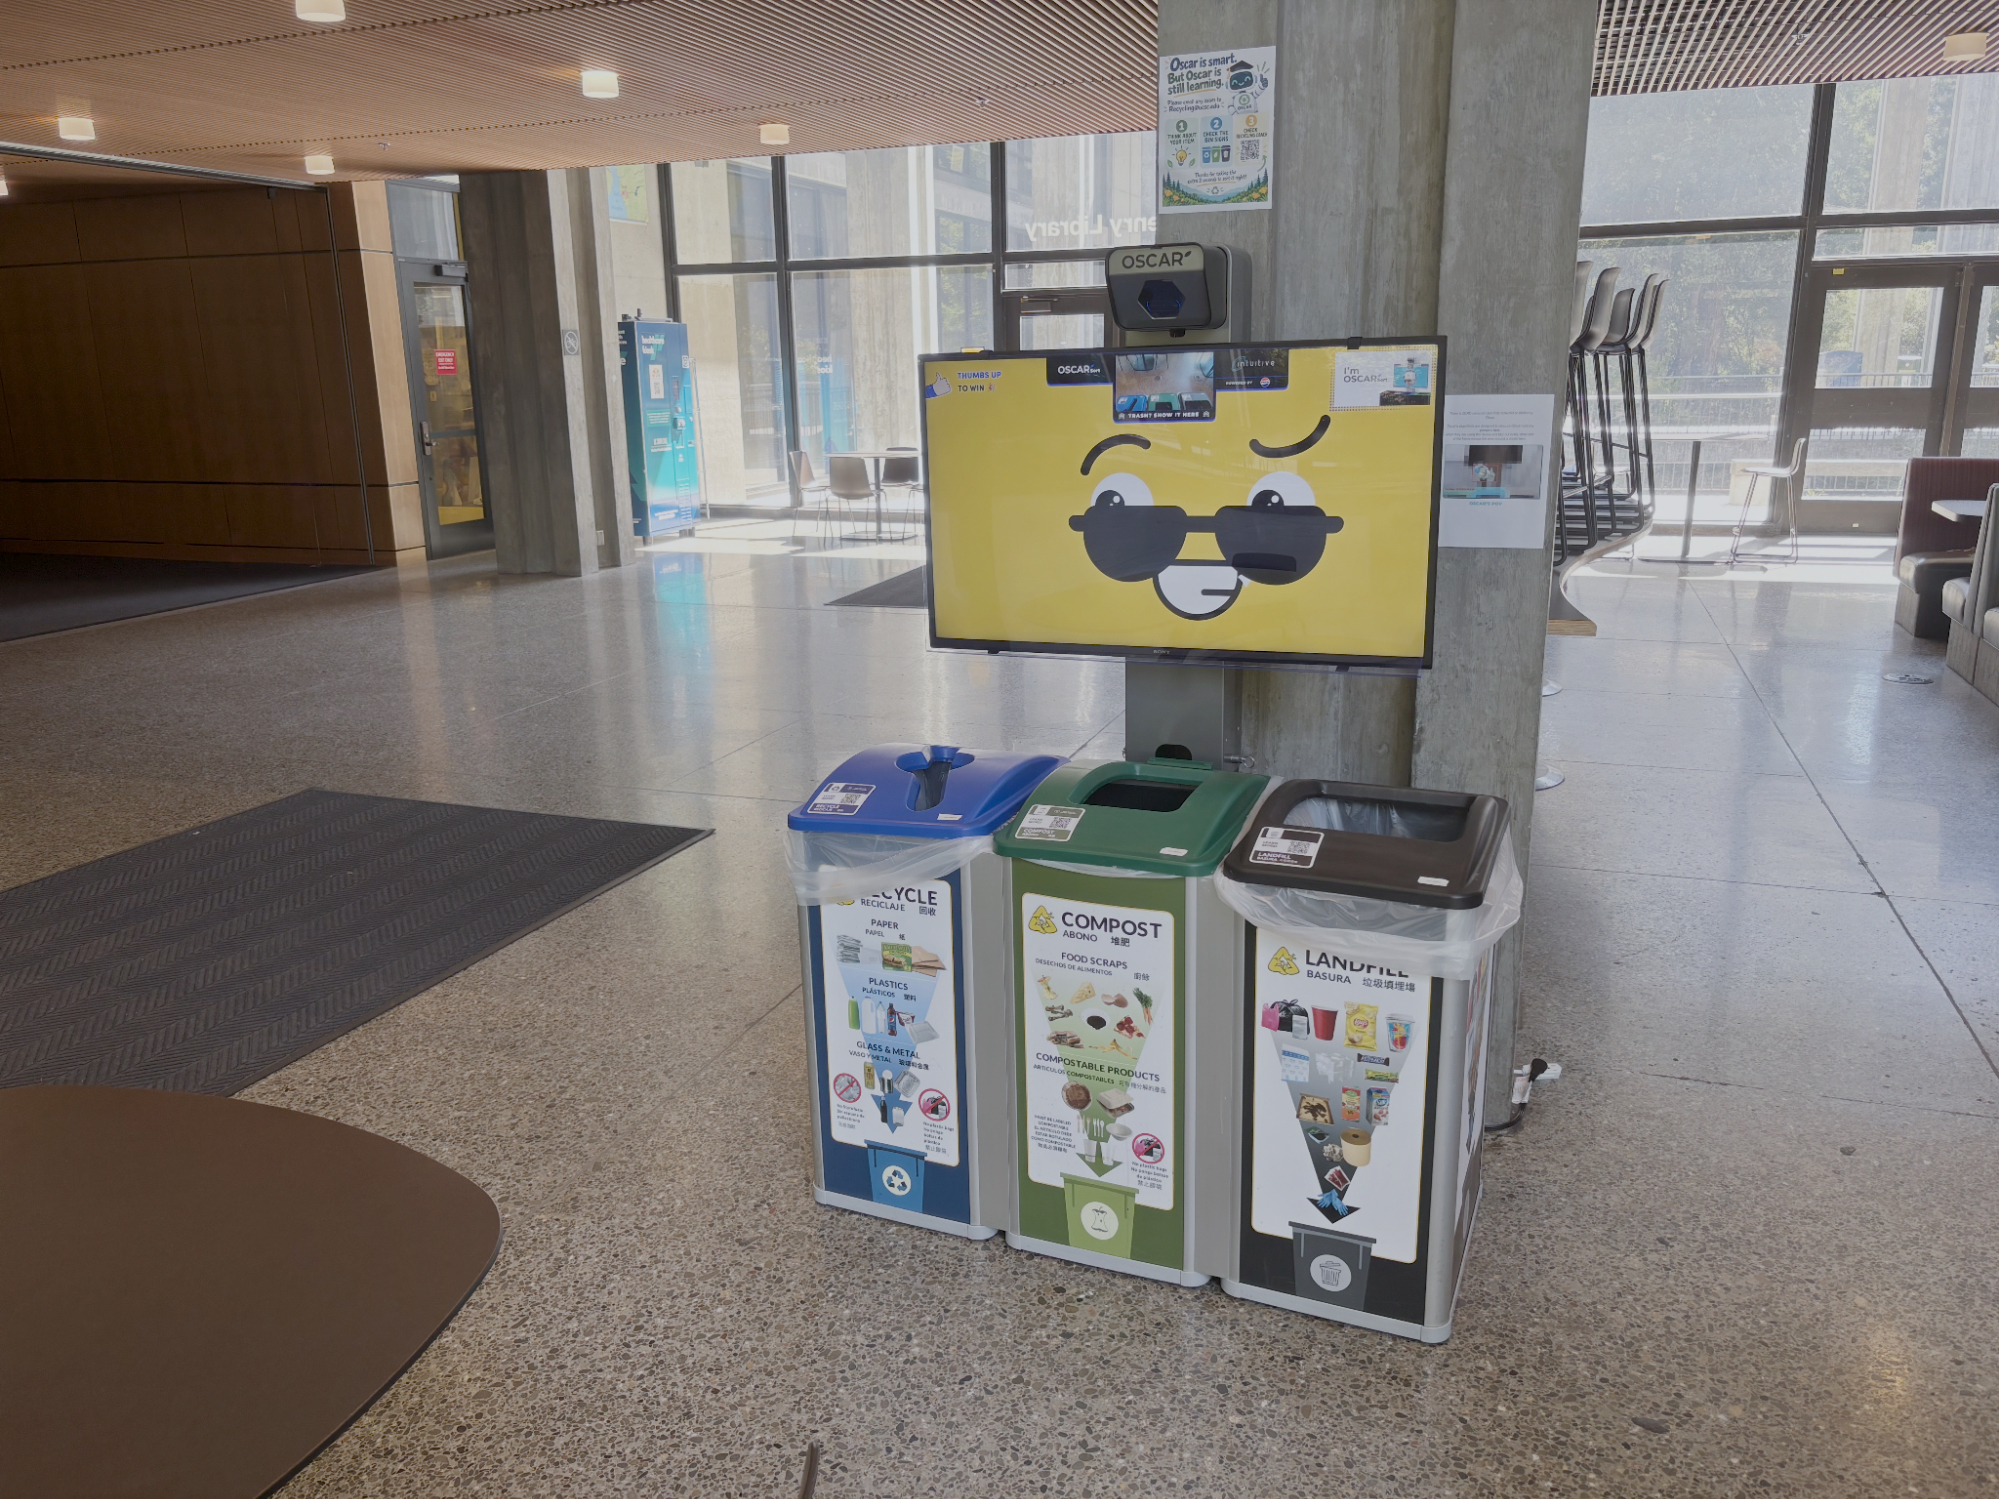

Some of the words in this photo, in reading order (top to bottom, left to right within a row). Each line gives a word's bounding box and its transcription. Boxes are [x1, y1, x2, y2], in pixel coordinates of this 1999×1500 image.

[1170, 57, 1198, 72] Oscar
[1200, 57, 1206, 67] is
[1208, 53, 1237, 67] smart.
[1168, 72, 1184, 84] But
[1186, 69, 1212, 81] Oscar
[1214, 67, 1221, 76] is
[1168, 83, 1184, 95] still
[1187, 79, 1224, 92] learning.
[1213, 120, 1219, 128] 2
[1122, 252, 1184, 269] OSCAR
[957, 372, 989, 380] THUMBS
[861, 899, 905, 911] RECICLAJE
[919, 906, 936, 916] 回收
[871, 919, 898, 929] PAPER
[1062, 912, 1162, 938] COMPOST
[866, 929, 885, 937] PAPEL
[1063, 930, 1098, 942] ABONO
[1111, 936, 1130, 947] 堆肥
[1036, 958, 1066, 968] DESECHOS
[1077, 966, 1112, 976] ALIMENTOS
[1062, 952, 1088, 963] FOOD
[1090, 957, 1128, 970] SCRAPS
[1307, 970, 1351, 984] BASURA
[869, 978, 908, 990] PLASTICS
[857, 1041, 883, 1052] GLASS
[893, 1047, 920, 1059] METAL
[872, 1055, 892, 1063] METAL
[1036, 1052, 1105, 1072] COMPOSTABLE
[1108, 1066, 1160, 1082] PRODUCTS
